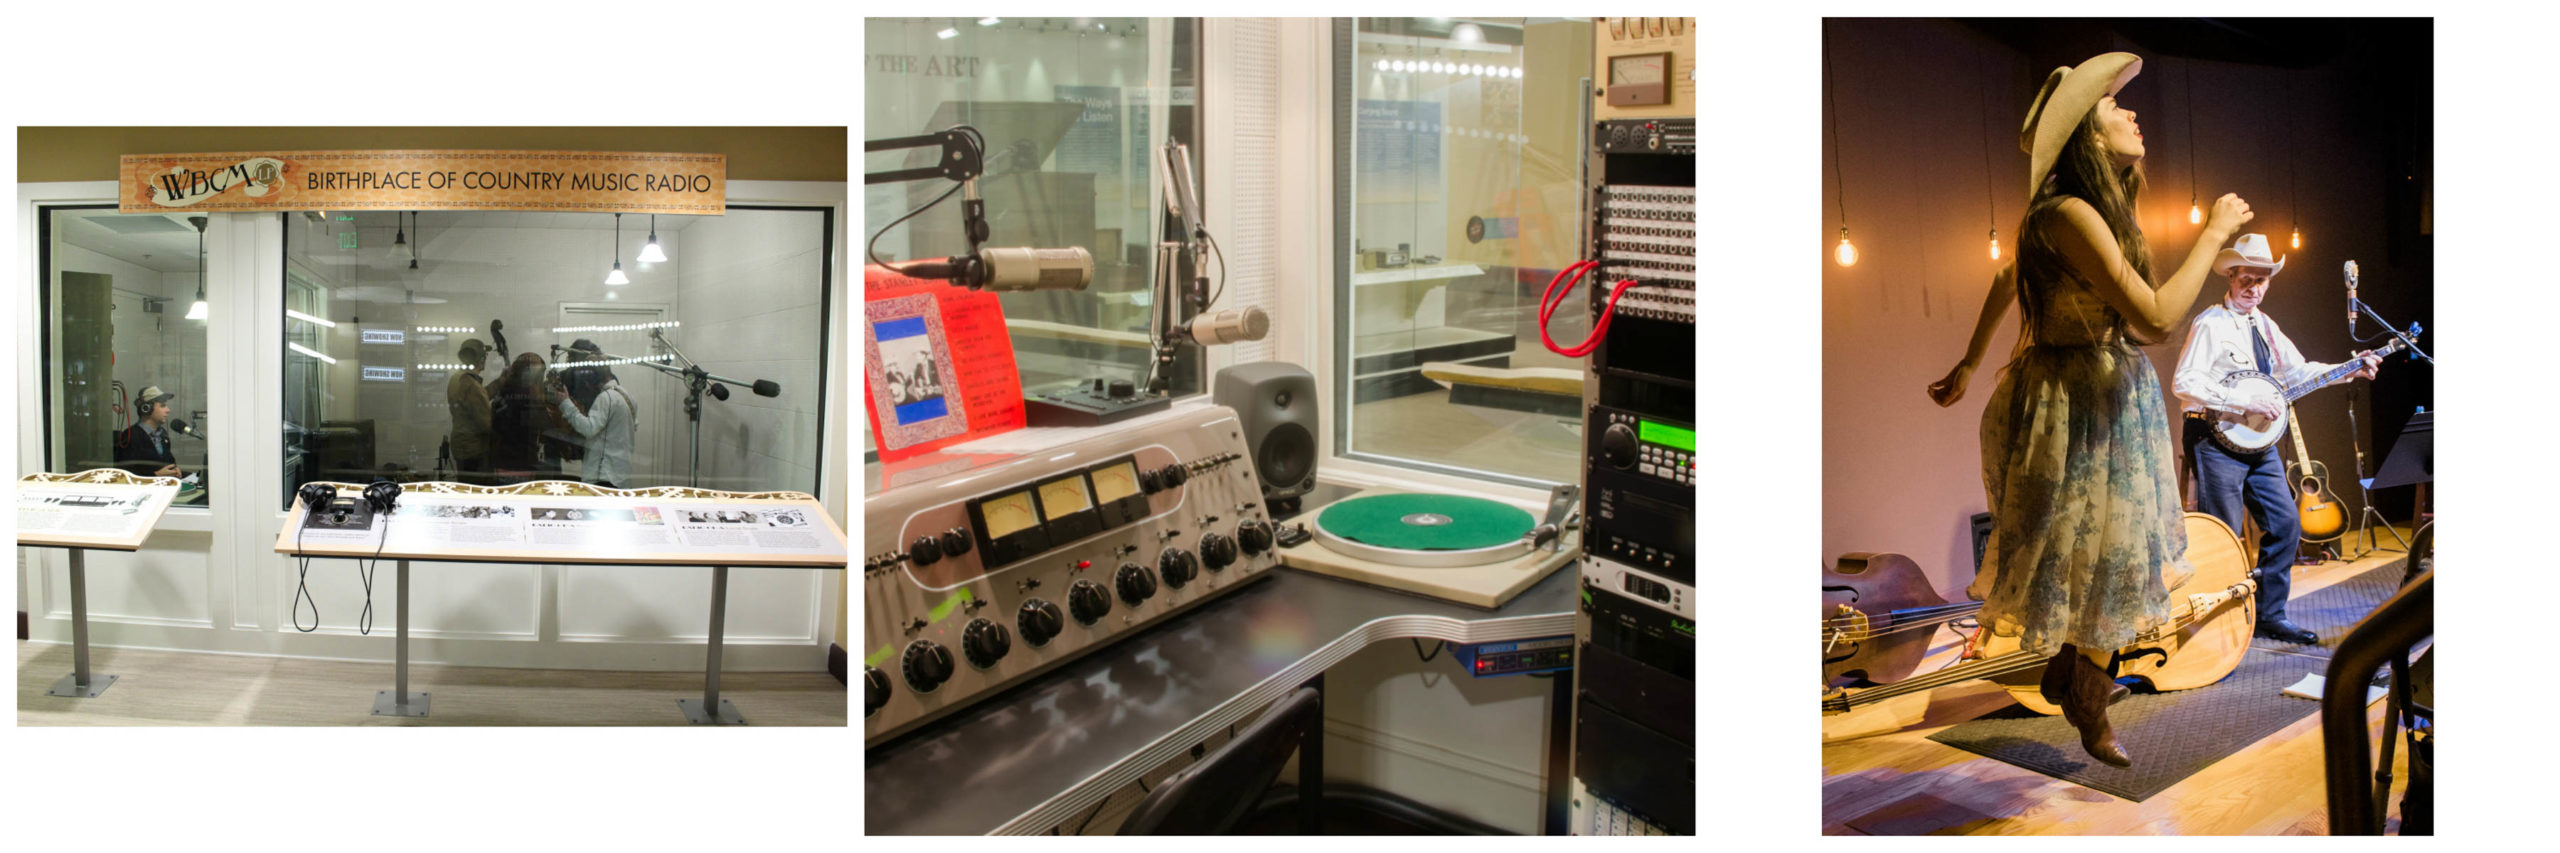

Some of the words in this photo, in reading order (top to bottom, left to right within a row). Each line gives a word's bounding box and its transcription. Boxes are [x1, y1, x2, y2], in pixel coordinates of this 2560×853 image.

[875, 54, 919, 73] THE
[923, 54, 980, 77] ART
[1085, 97, 1113, 110] Ways
[1083, 111, 1113, 122] Listen
[160, 163, 255, 201] WBCM
[258, 166, 275, 181] LP
[308, 171, 422, 190] BIRTHPLACE
[428, 171, 457, 190] OF
[463, 171, 565, 190] COUNTRY
[571, 173, 640, 191] MUSIC
[646, 174, 712, 193] RADIO
